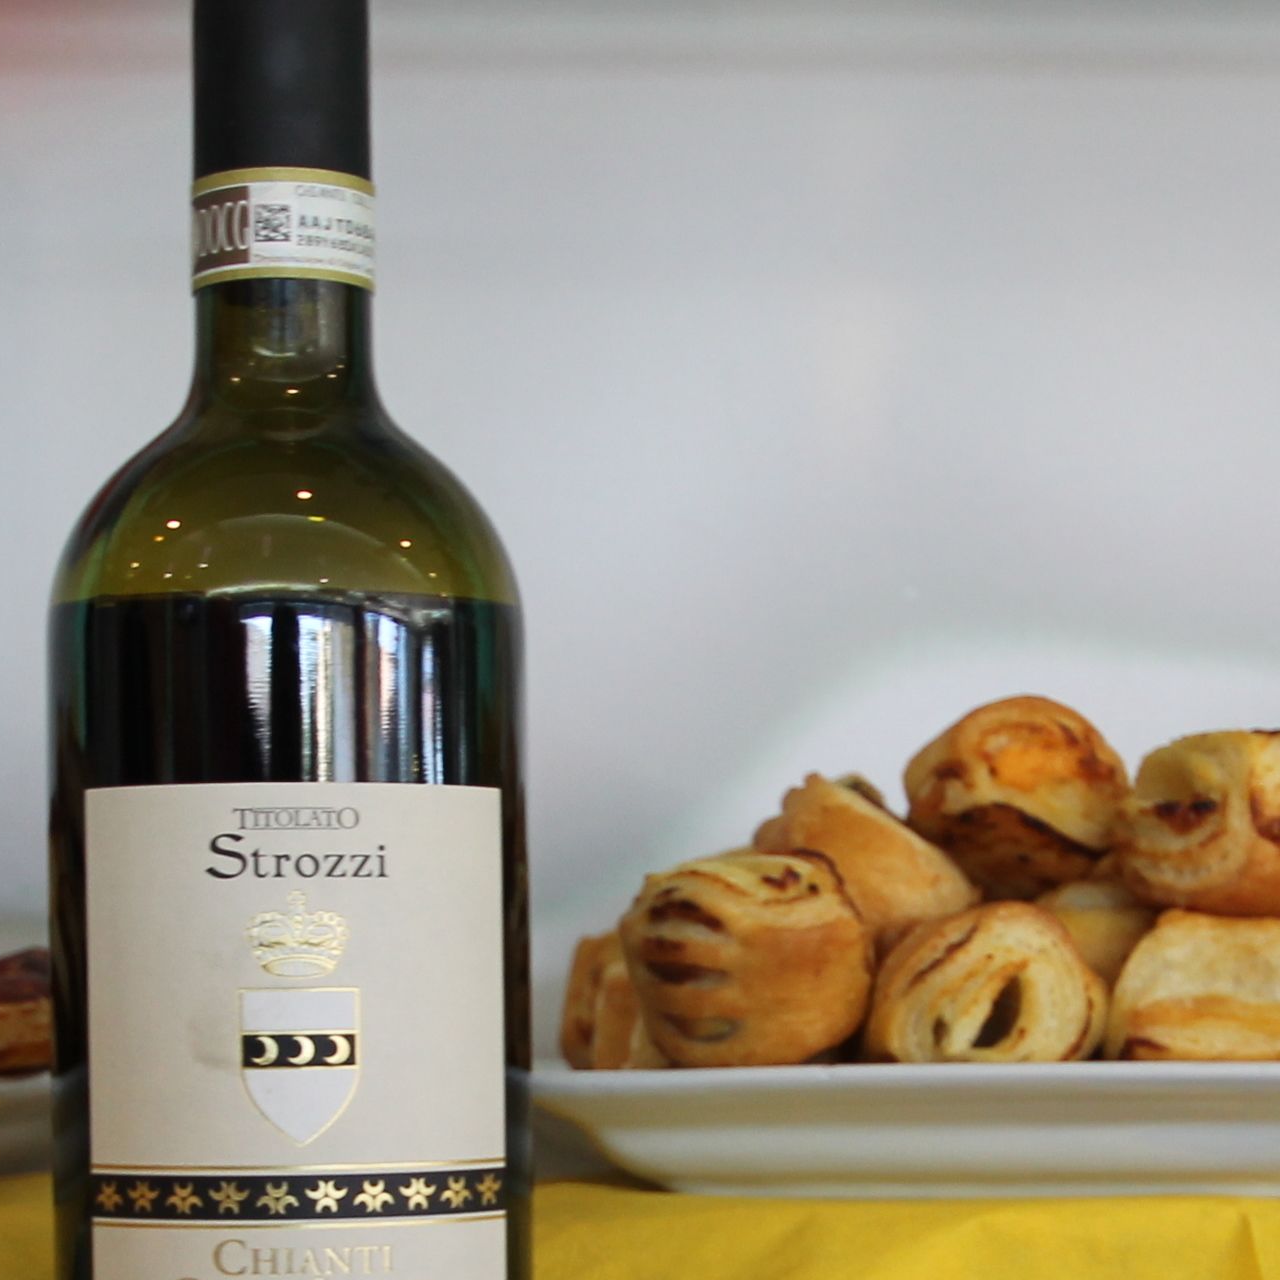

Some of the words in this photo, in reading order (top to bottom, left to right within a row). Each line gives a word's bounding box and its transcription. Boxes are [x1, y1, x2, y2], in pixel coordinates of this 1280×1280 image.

[233, 806, 360, 830] TITOLATO
[205, 833, 390, 879] Strozzi
[212, 1238, 394, 1276] CHIANTI
